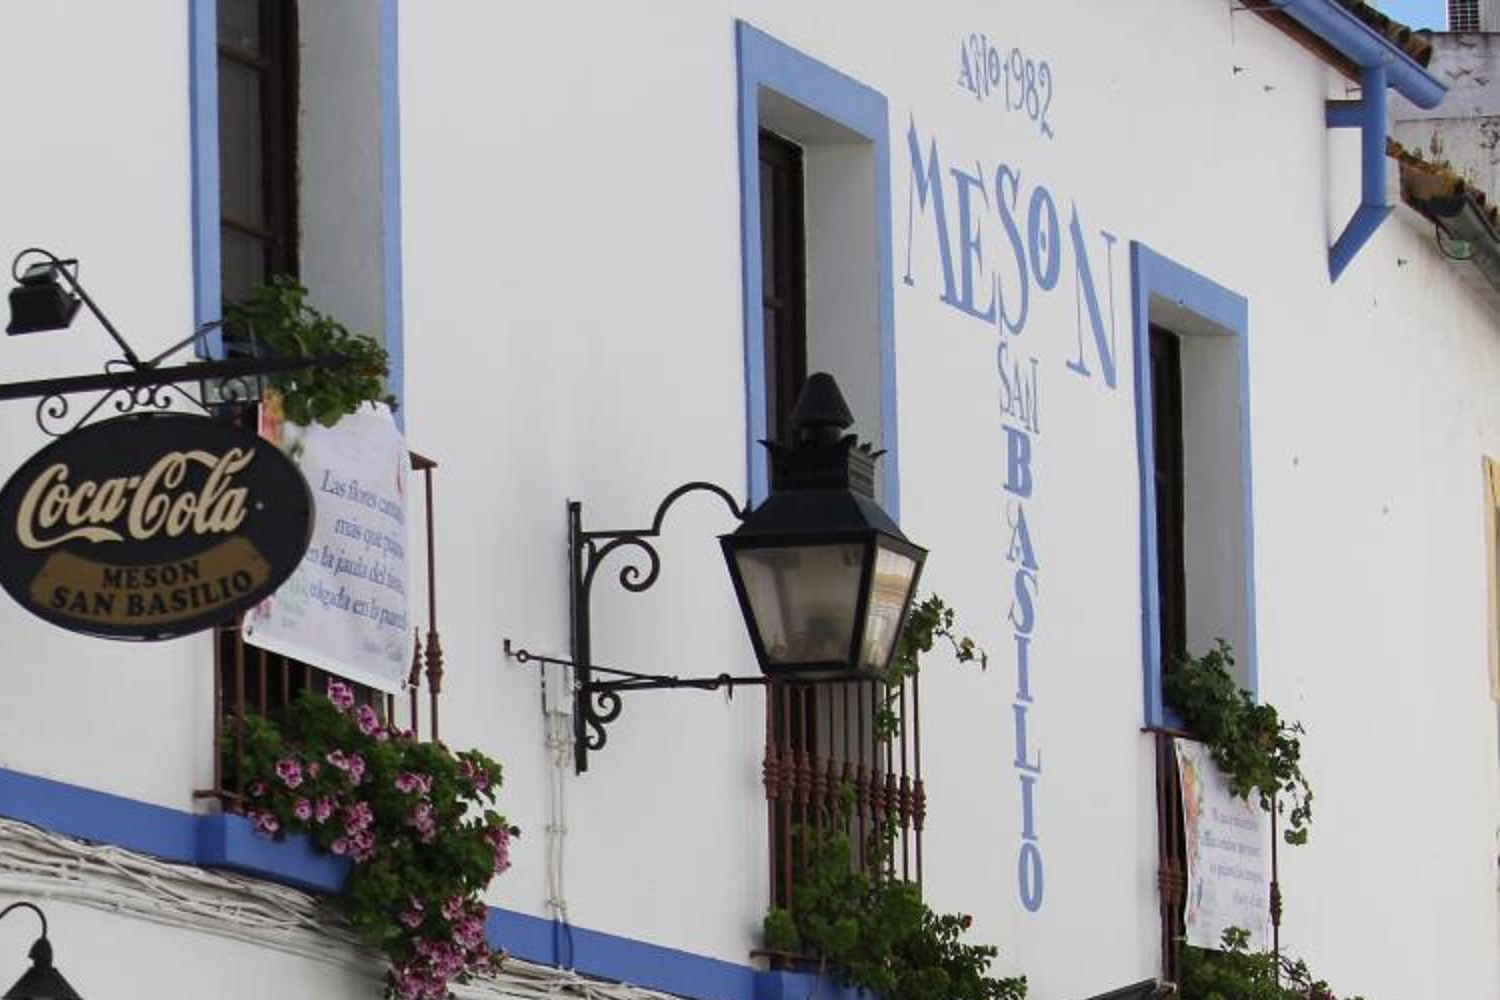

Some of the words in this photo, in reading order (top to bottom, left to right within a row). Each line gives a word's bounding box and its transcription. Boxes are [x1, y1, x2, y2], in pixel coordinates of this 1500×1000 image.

[1003, 46, 1055, 141] 1982
[903, 109, 1117, 391] MESON
[997, 341, 1041, 434] SAN
[16, 447, 256, 550] Coca-Cola
[50, 585, 117, 617] SAN
[126, 569, 255, 617] BASILIO
[101, 559, 201, 592] MESON
[1001, 423, 1044, 913] BASILIO
